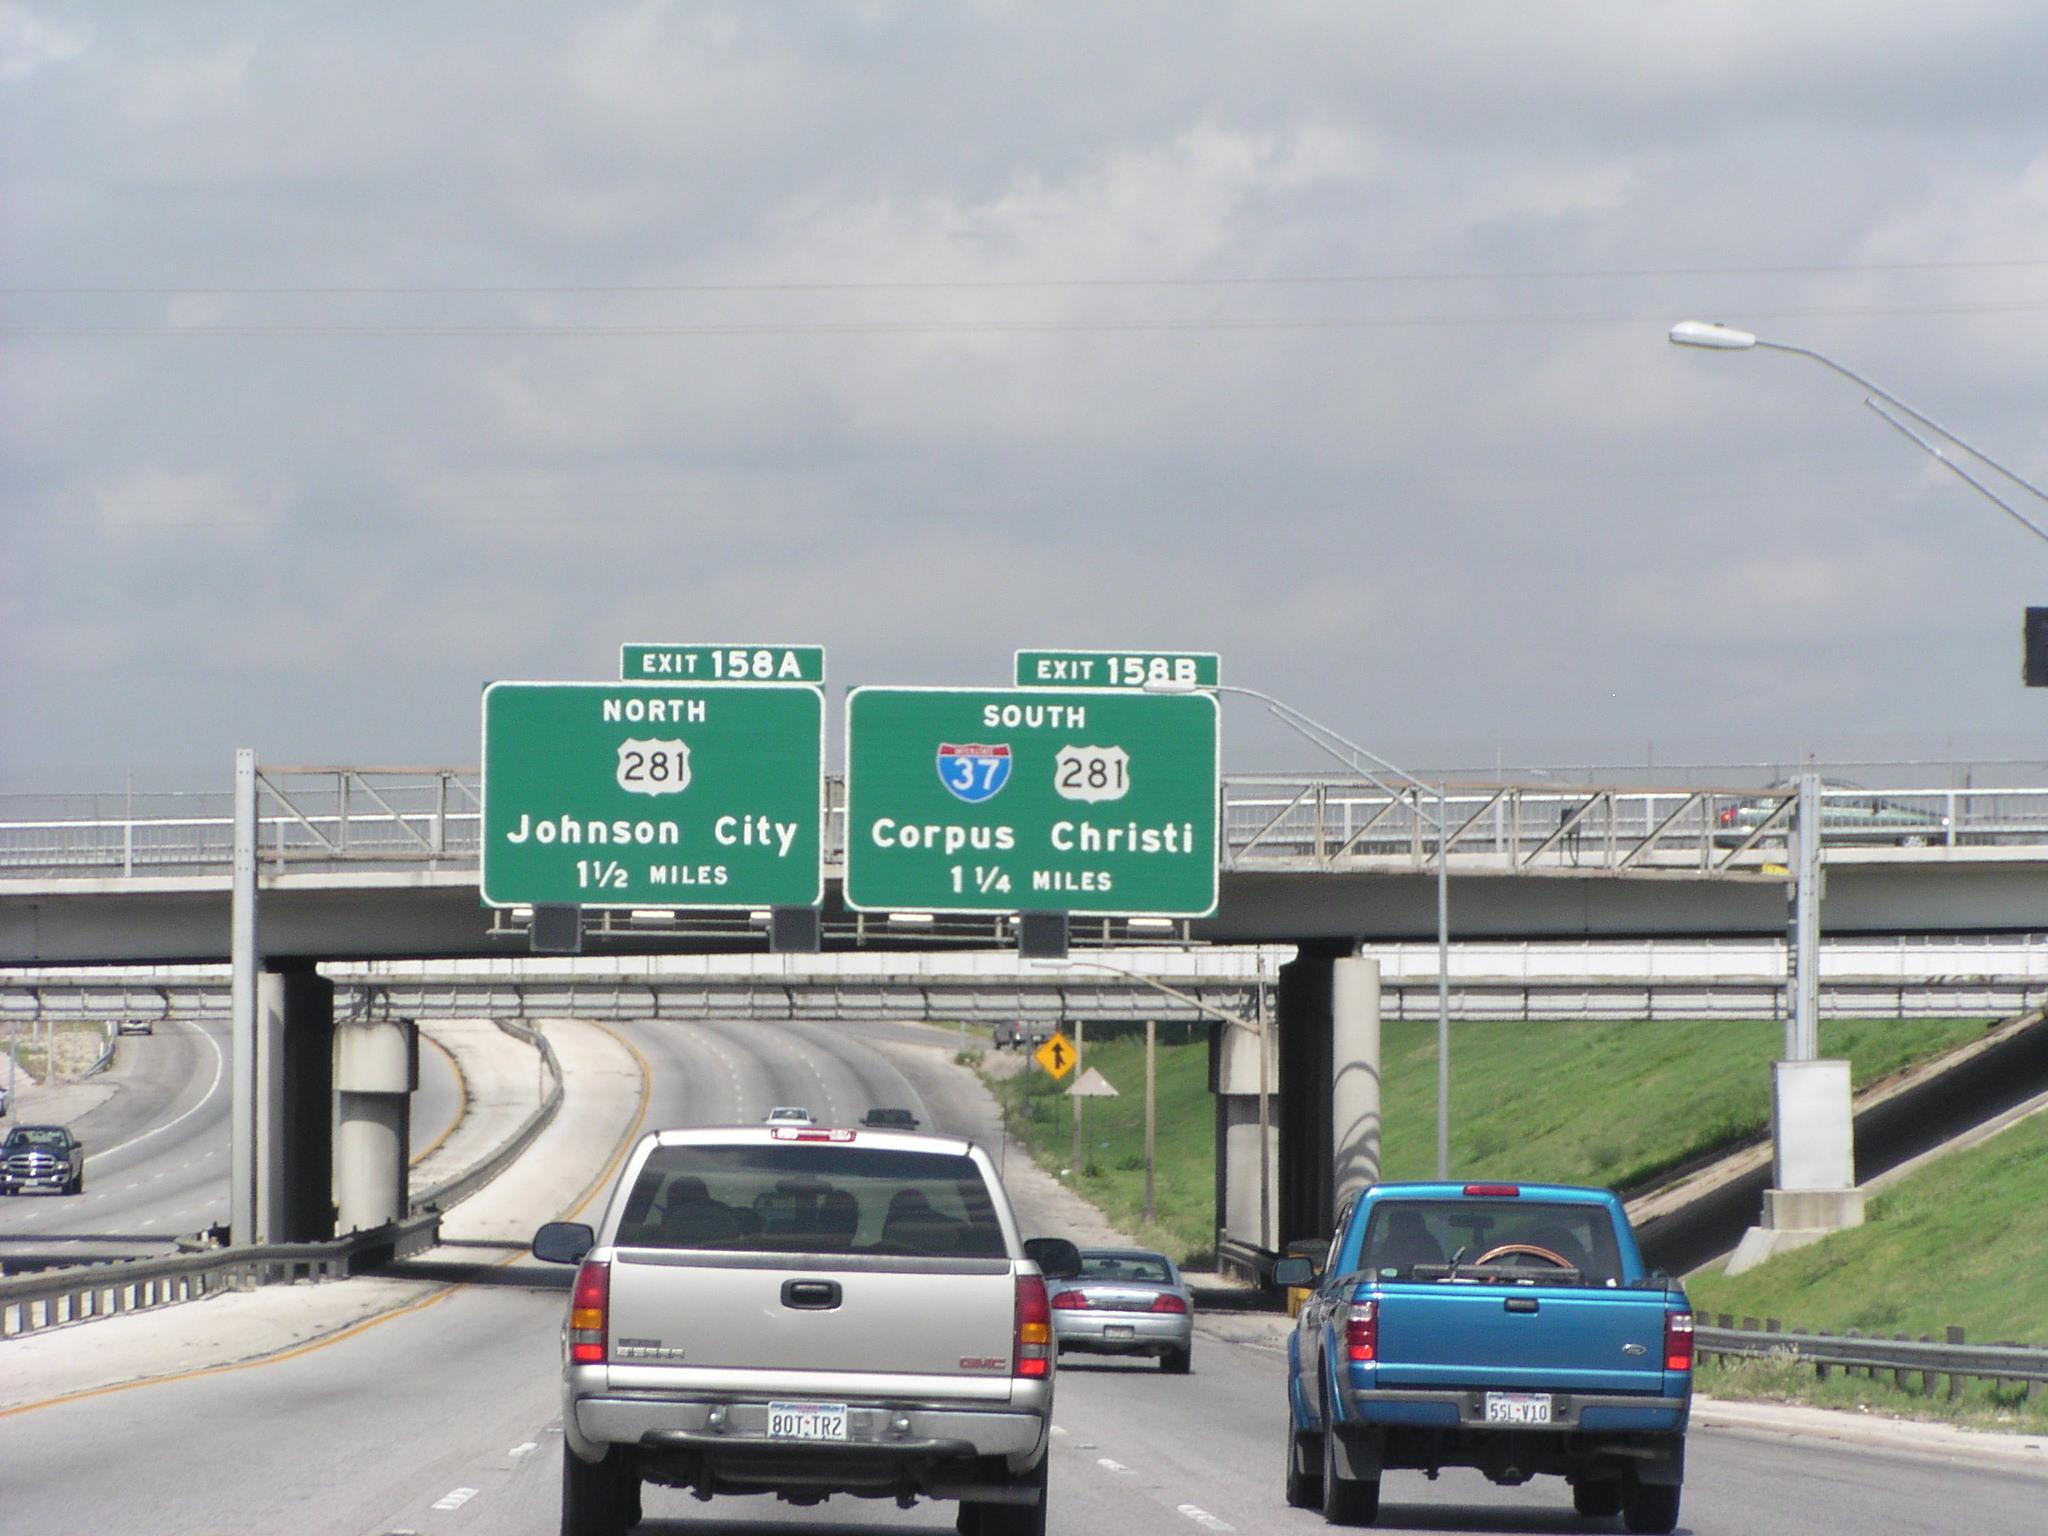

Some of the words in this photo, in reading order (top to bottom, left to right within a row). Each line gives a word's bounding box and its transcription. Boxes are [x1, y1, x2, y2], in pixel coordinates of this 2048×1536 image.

[642, 653, 698, 673] EXIT
[711, 650, 802, 678] 158A
[1037, 659, 1094, 680] EXIT
[1107, 657, 1197, 682] 158B
[603, 698, 706, 723] NORTH
[983, 704, 1085, 729] SOUTH
[624, 751, 684, 782] 281
[951, 757, 1000, 791] 37
[1062, 757, 1122, 789] 281
[506, 814, 679, 844] Johnson
[714, 814, 798, 857] City
[871, 817, 1015, 855] Corpus
[1051, 820, 1193, 854] Christi
[649, 865, 728, 885] MILES
[1032, 870, 1112, 892] MILES
